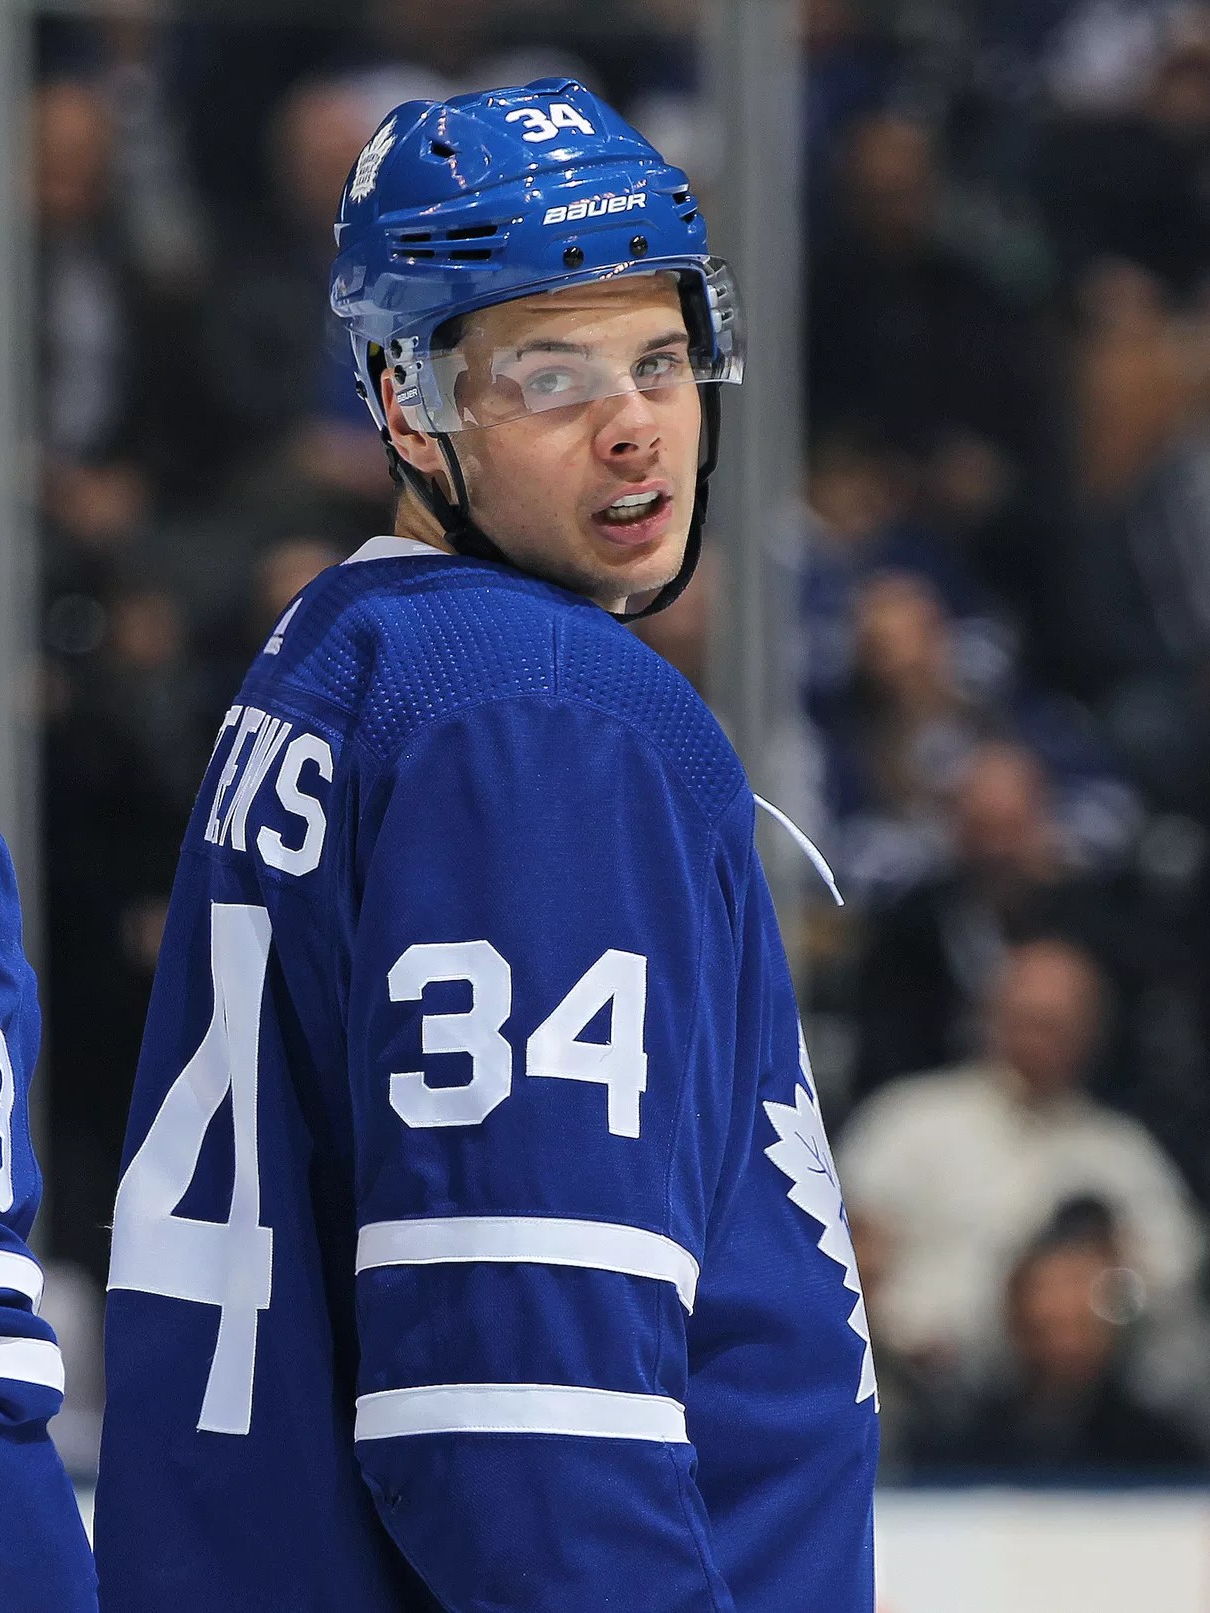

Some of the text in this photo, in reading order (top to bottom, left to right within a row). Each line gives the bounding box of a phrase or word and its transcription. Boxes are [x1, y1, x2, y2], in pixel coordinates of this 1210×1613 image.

[505, 103, 596, 143] 34
[543, 193, 647, 226] BAUER
[386, 940, 649, 1139] 34
[106, 899, 273, 1436] 4
